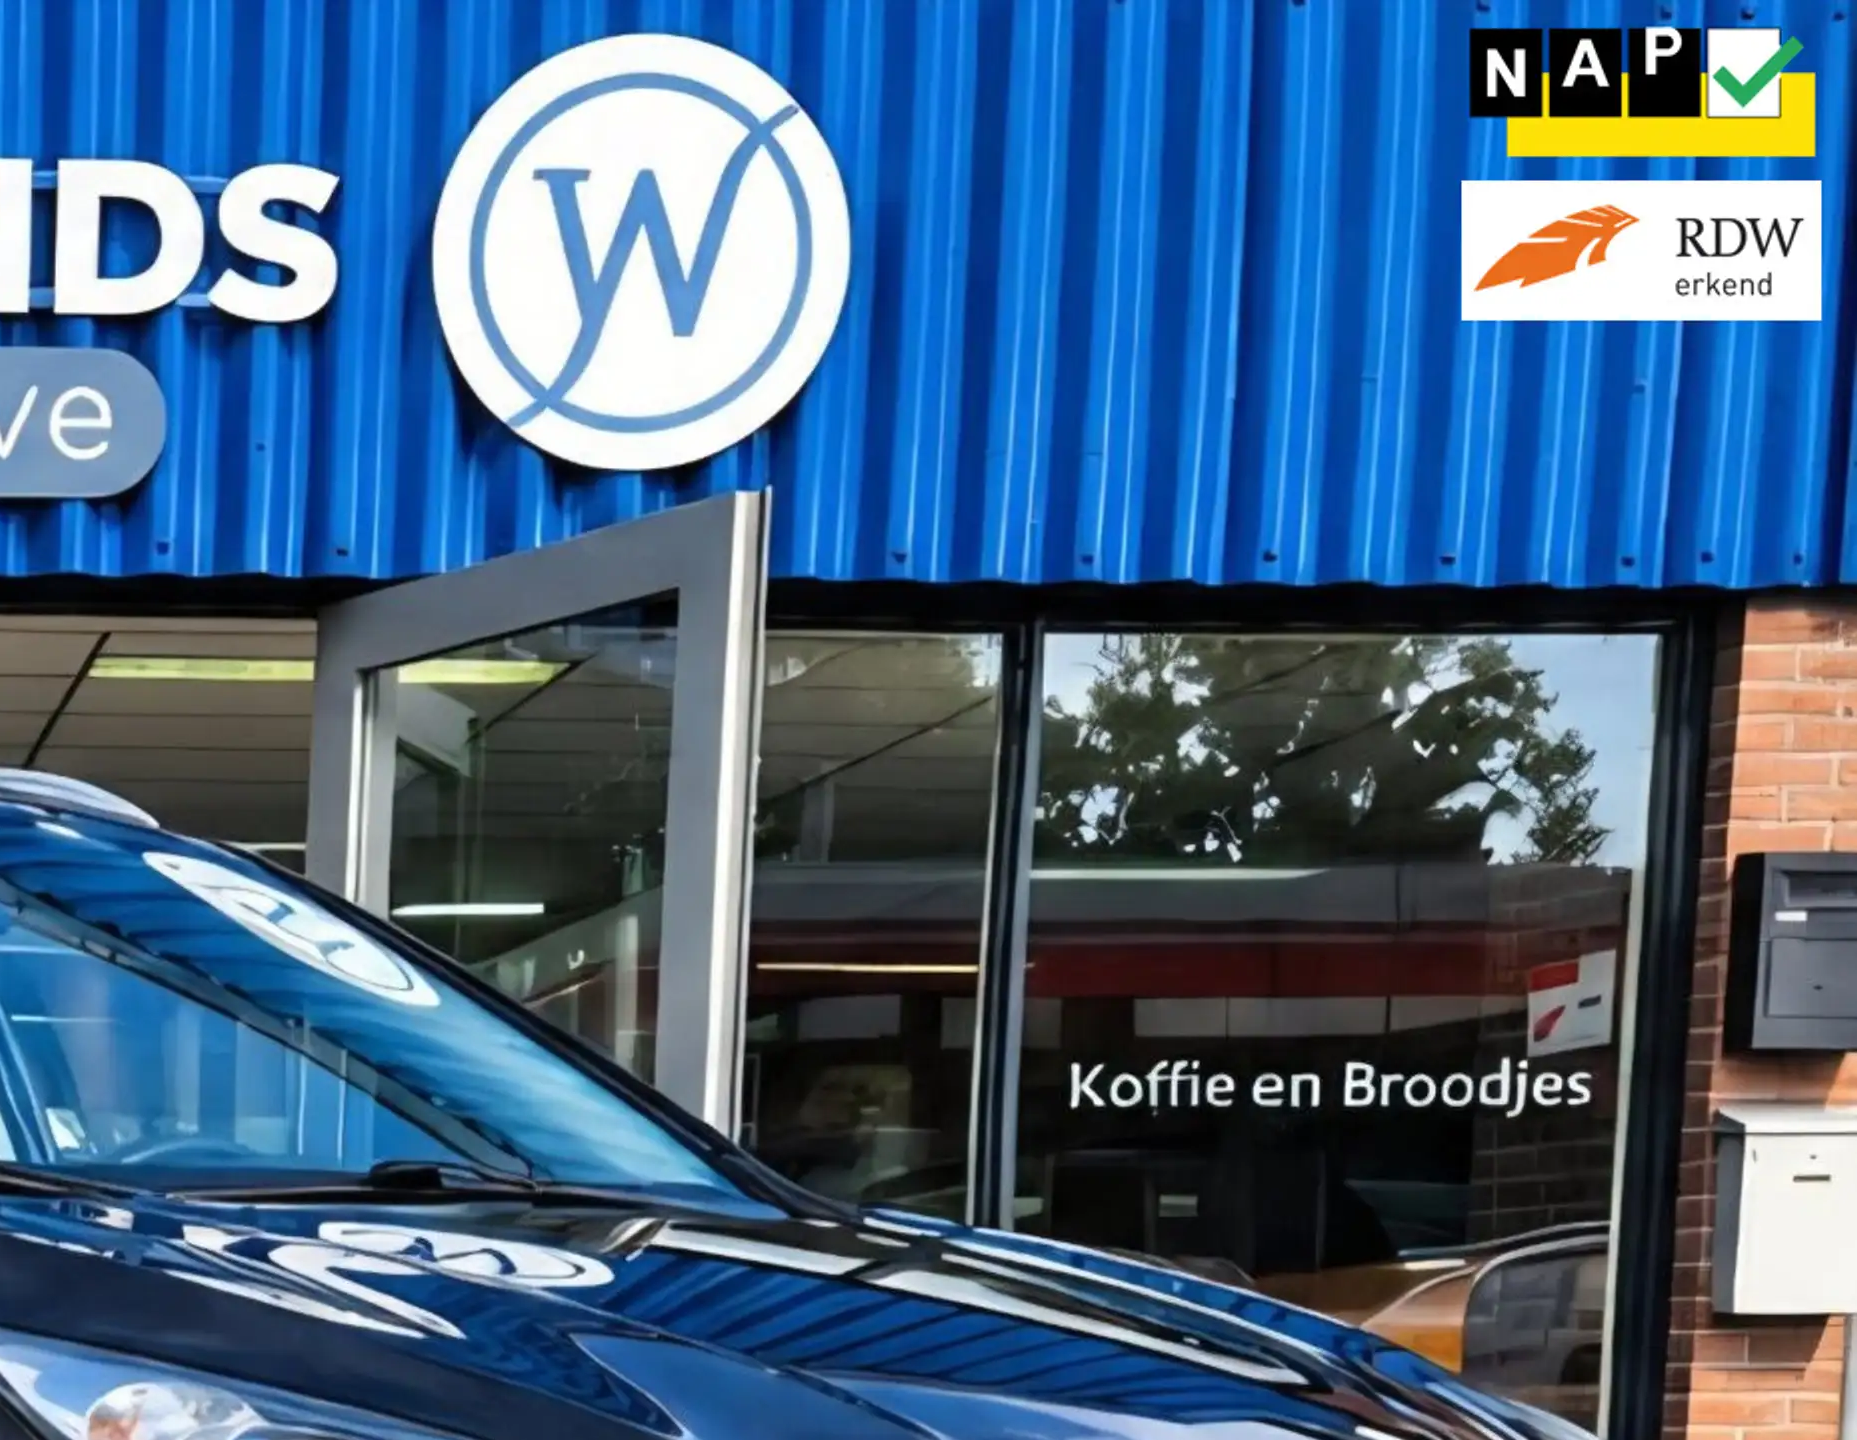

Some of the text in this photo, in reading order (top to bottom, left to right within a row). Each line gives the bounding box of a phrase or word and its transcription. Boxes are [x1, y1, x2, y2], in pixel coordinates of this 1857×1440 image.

[1069, 1056, 1593, 1119] Koffie en Broodjes
